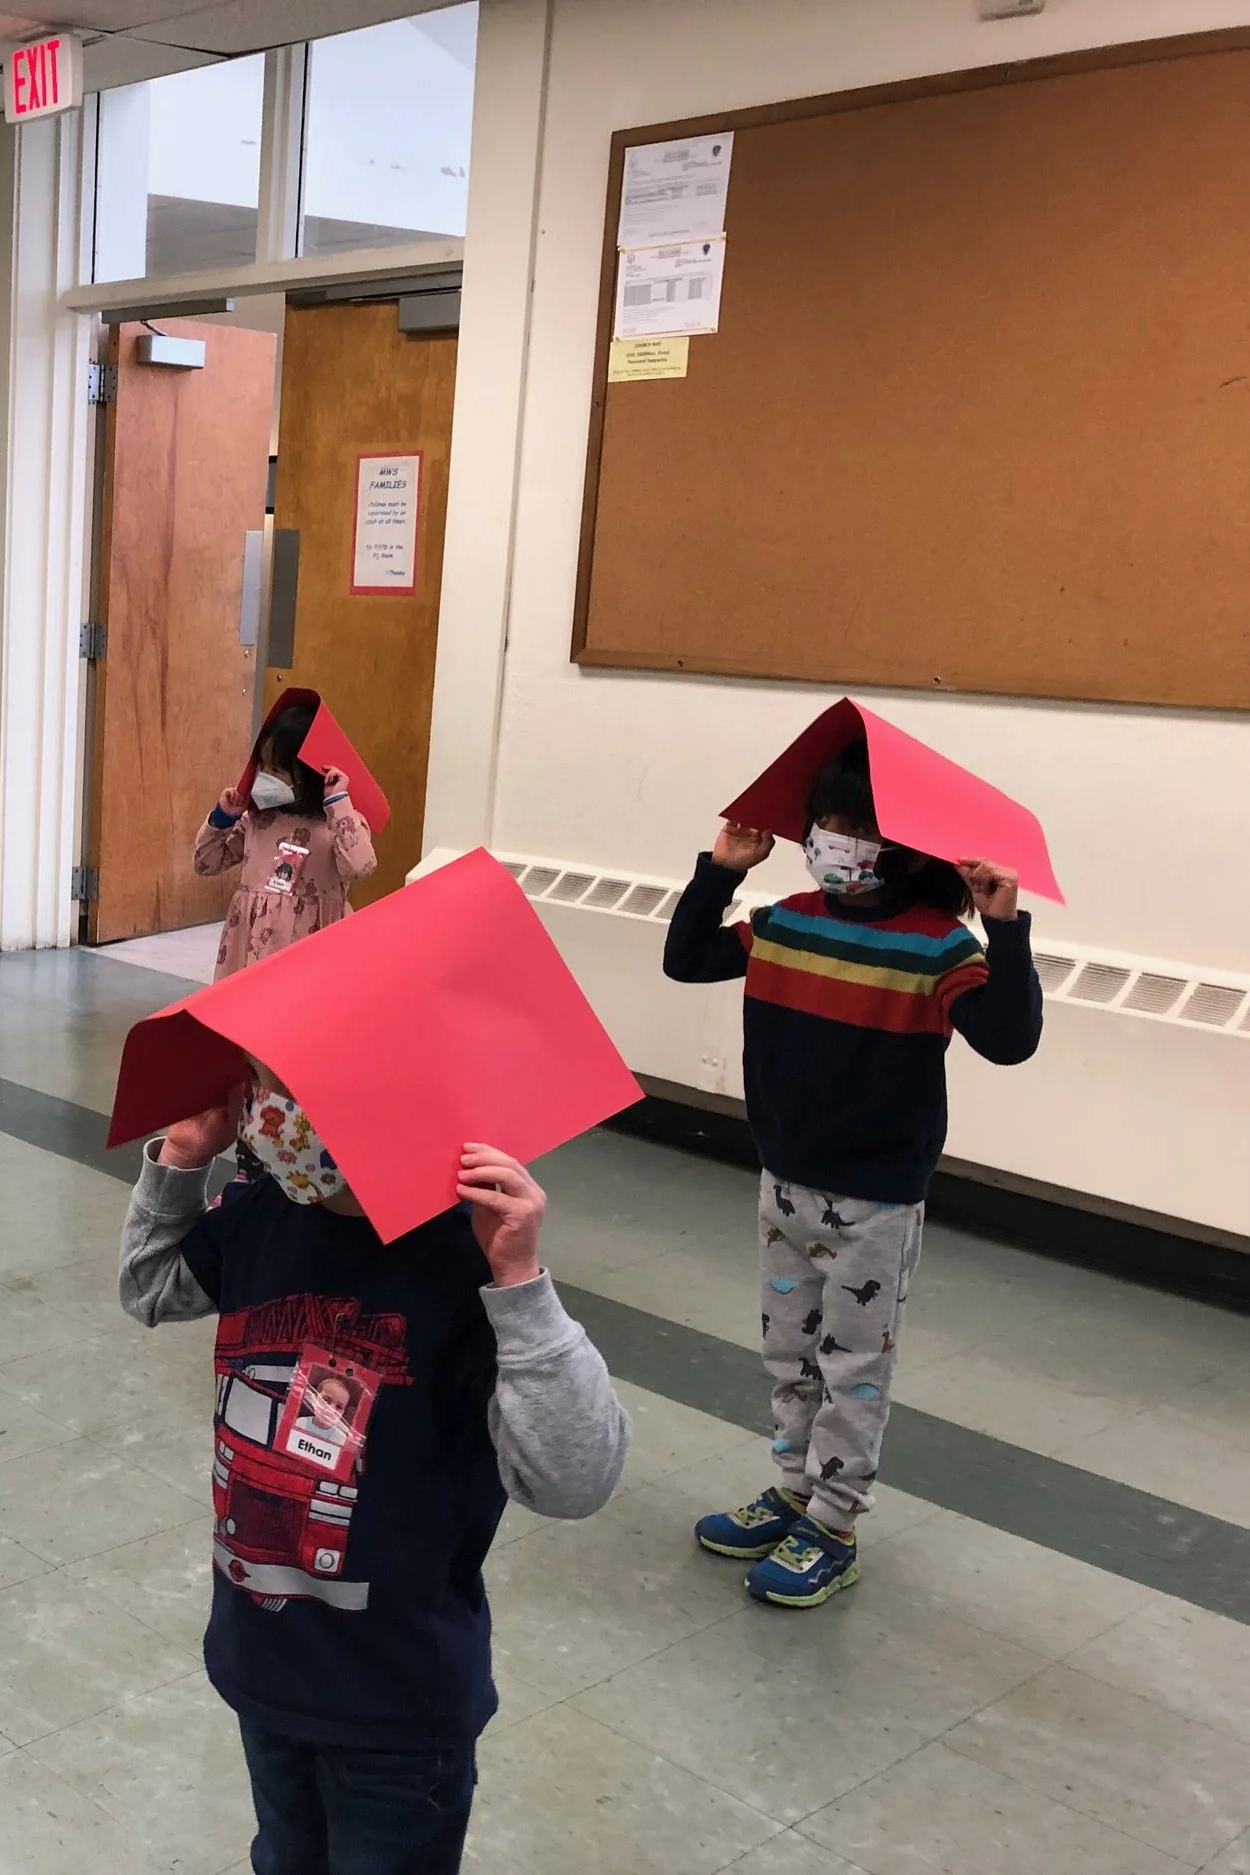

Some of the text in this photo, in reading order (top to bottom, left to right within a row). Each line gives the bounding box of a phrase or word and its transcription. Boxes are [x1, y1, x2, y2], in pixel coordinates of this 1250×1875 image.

[13, 39, 60, 114] EXIT
[379, 468, 398, 476] MWS
[369, 480, 407, 490] FAMILIES
[298, 1438, 332, 1461] Ethan
